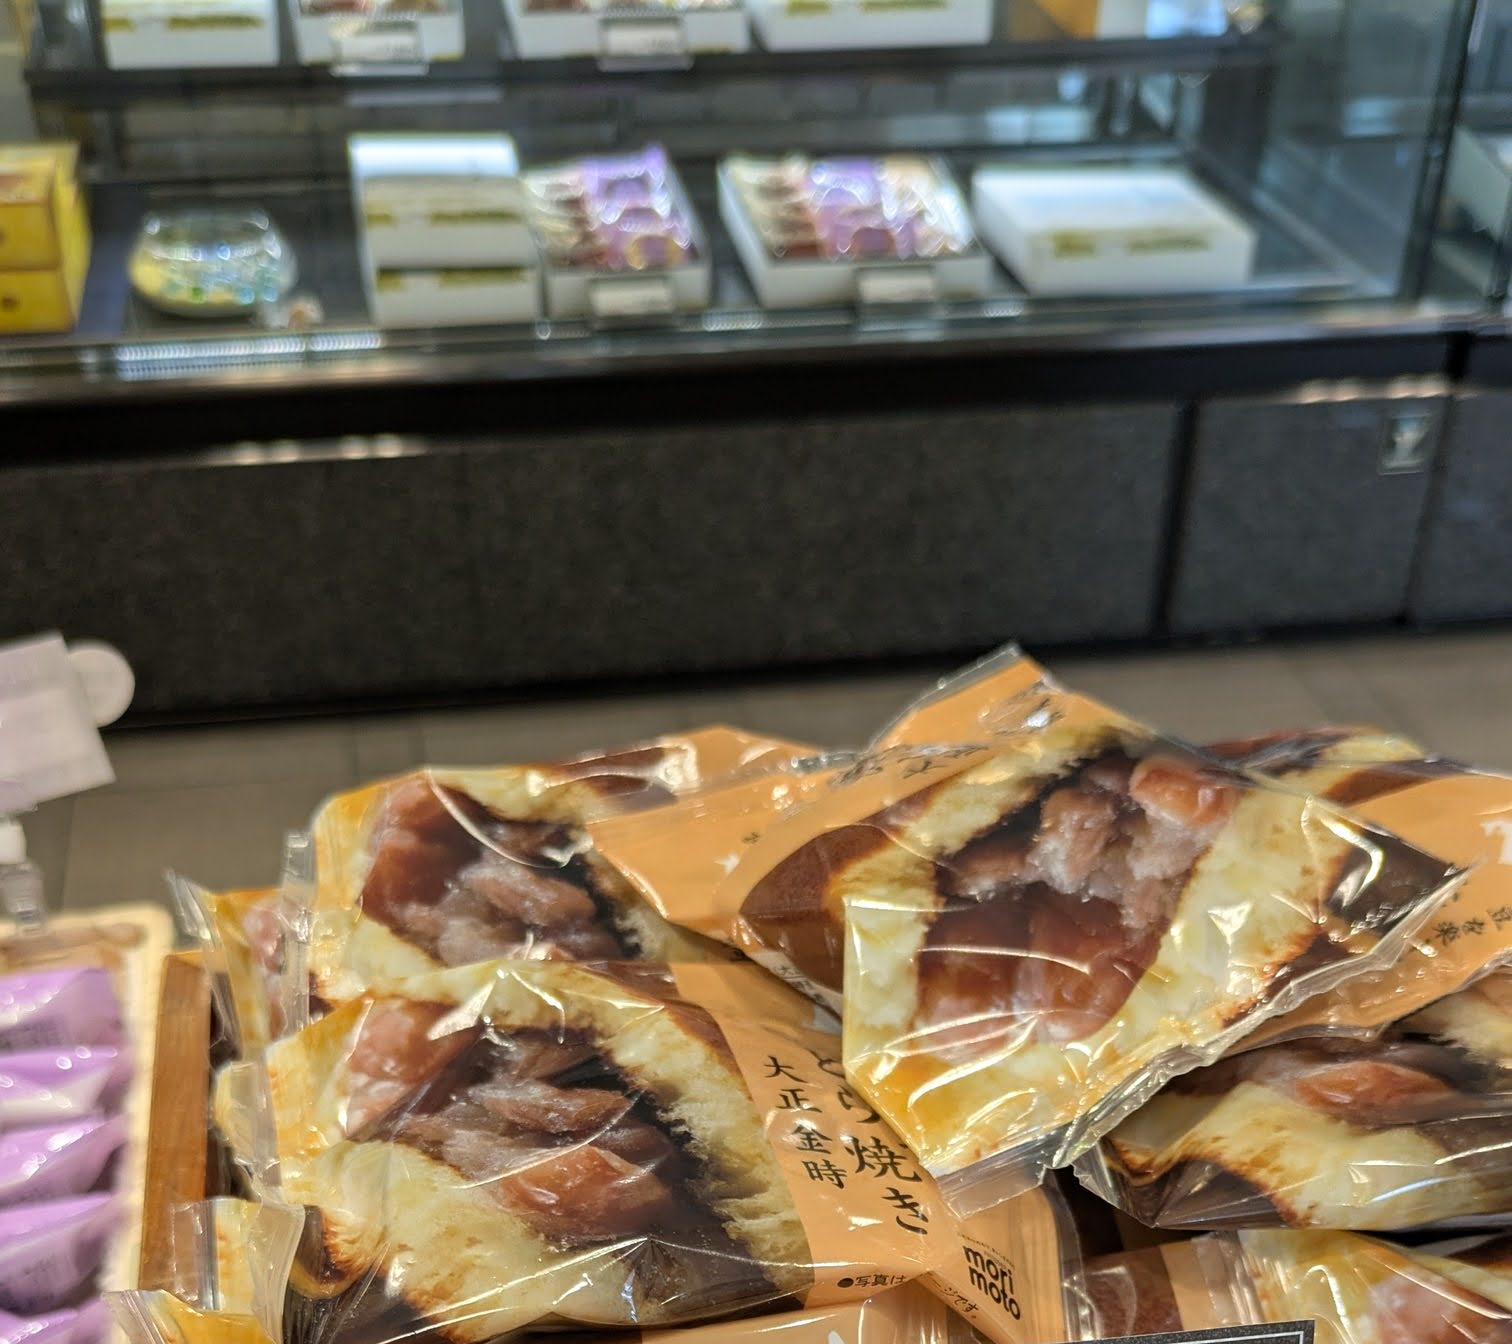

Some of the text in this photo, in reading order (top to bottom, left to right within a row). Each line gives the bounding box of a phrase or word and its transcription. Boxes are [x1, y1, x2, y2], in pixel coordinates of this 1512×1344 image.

[763, 1055, 848, 1189] 大正金時
[963, 1245, 1014, 1295] mori
[968, 1266, 1021, 1320] moto
